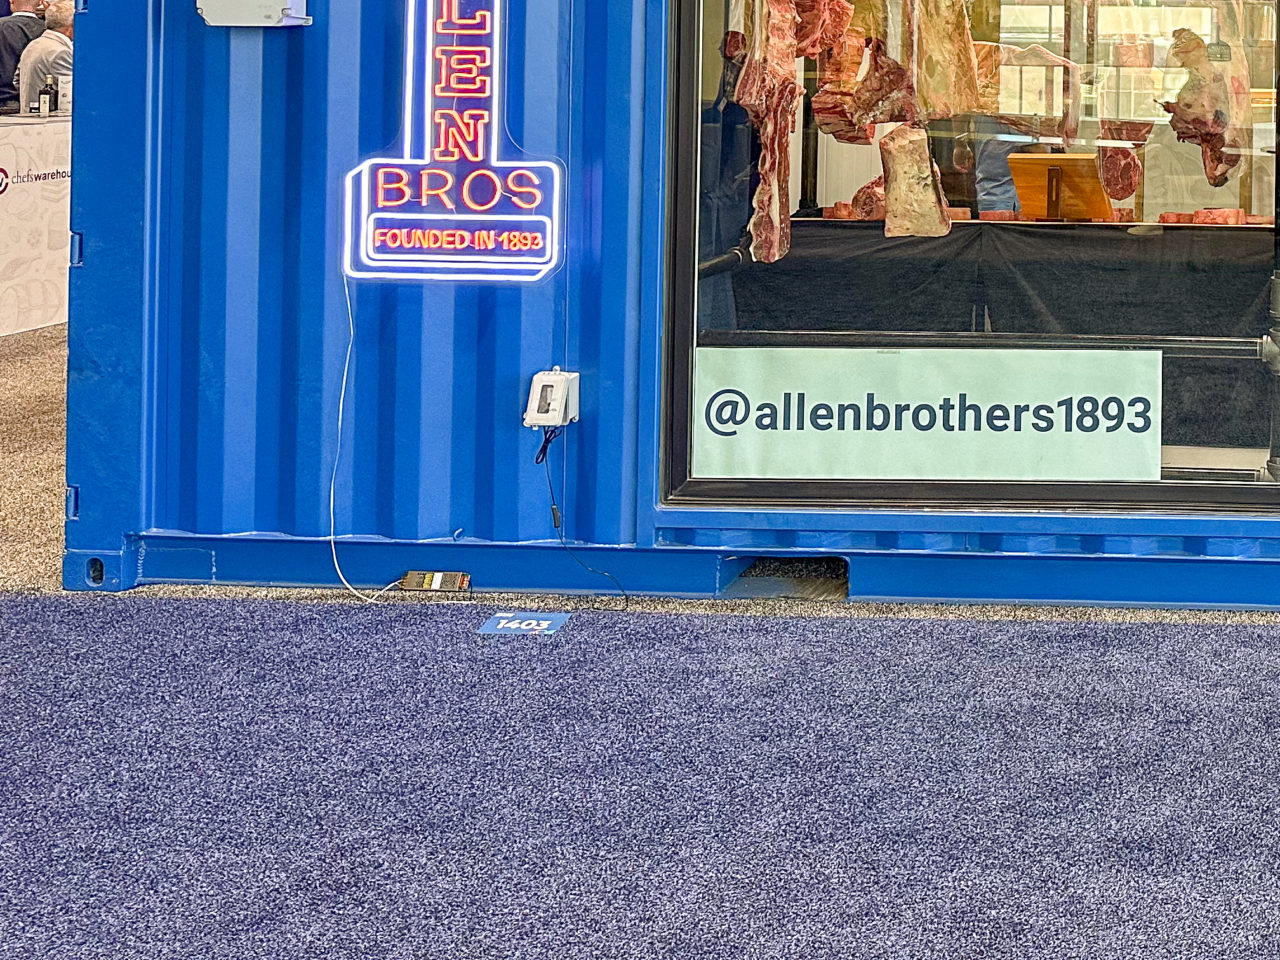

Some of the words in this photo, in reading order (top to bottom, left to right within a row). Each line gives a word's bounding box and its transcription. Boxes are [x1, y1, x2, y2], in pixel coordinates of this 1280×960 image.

[377, 168, 542, 210] BROS
[374, 228, 472, 249] FOUNDED
[475, 229, 496, 250] IN
[500, 230, 544, 251] 1893
[704, 388, 1153, 437] @allenbrothers1893
[496, 619, 552, 630] 1403
